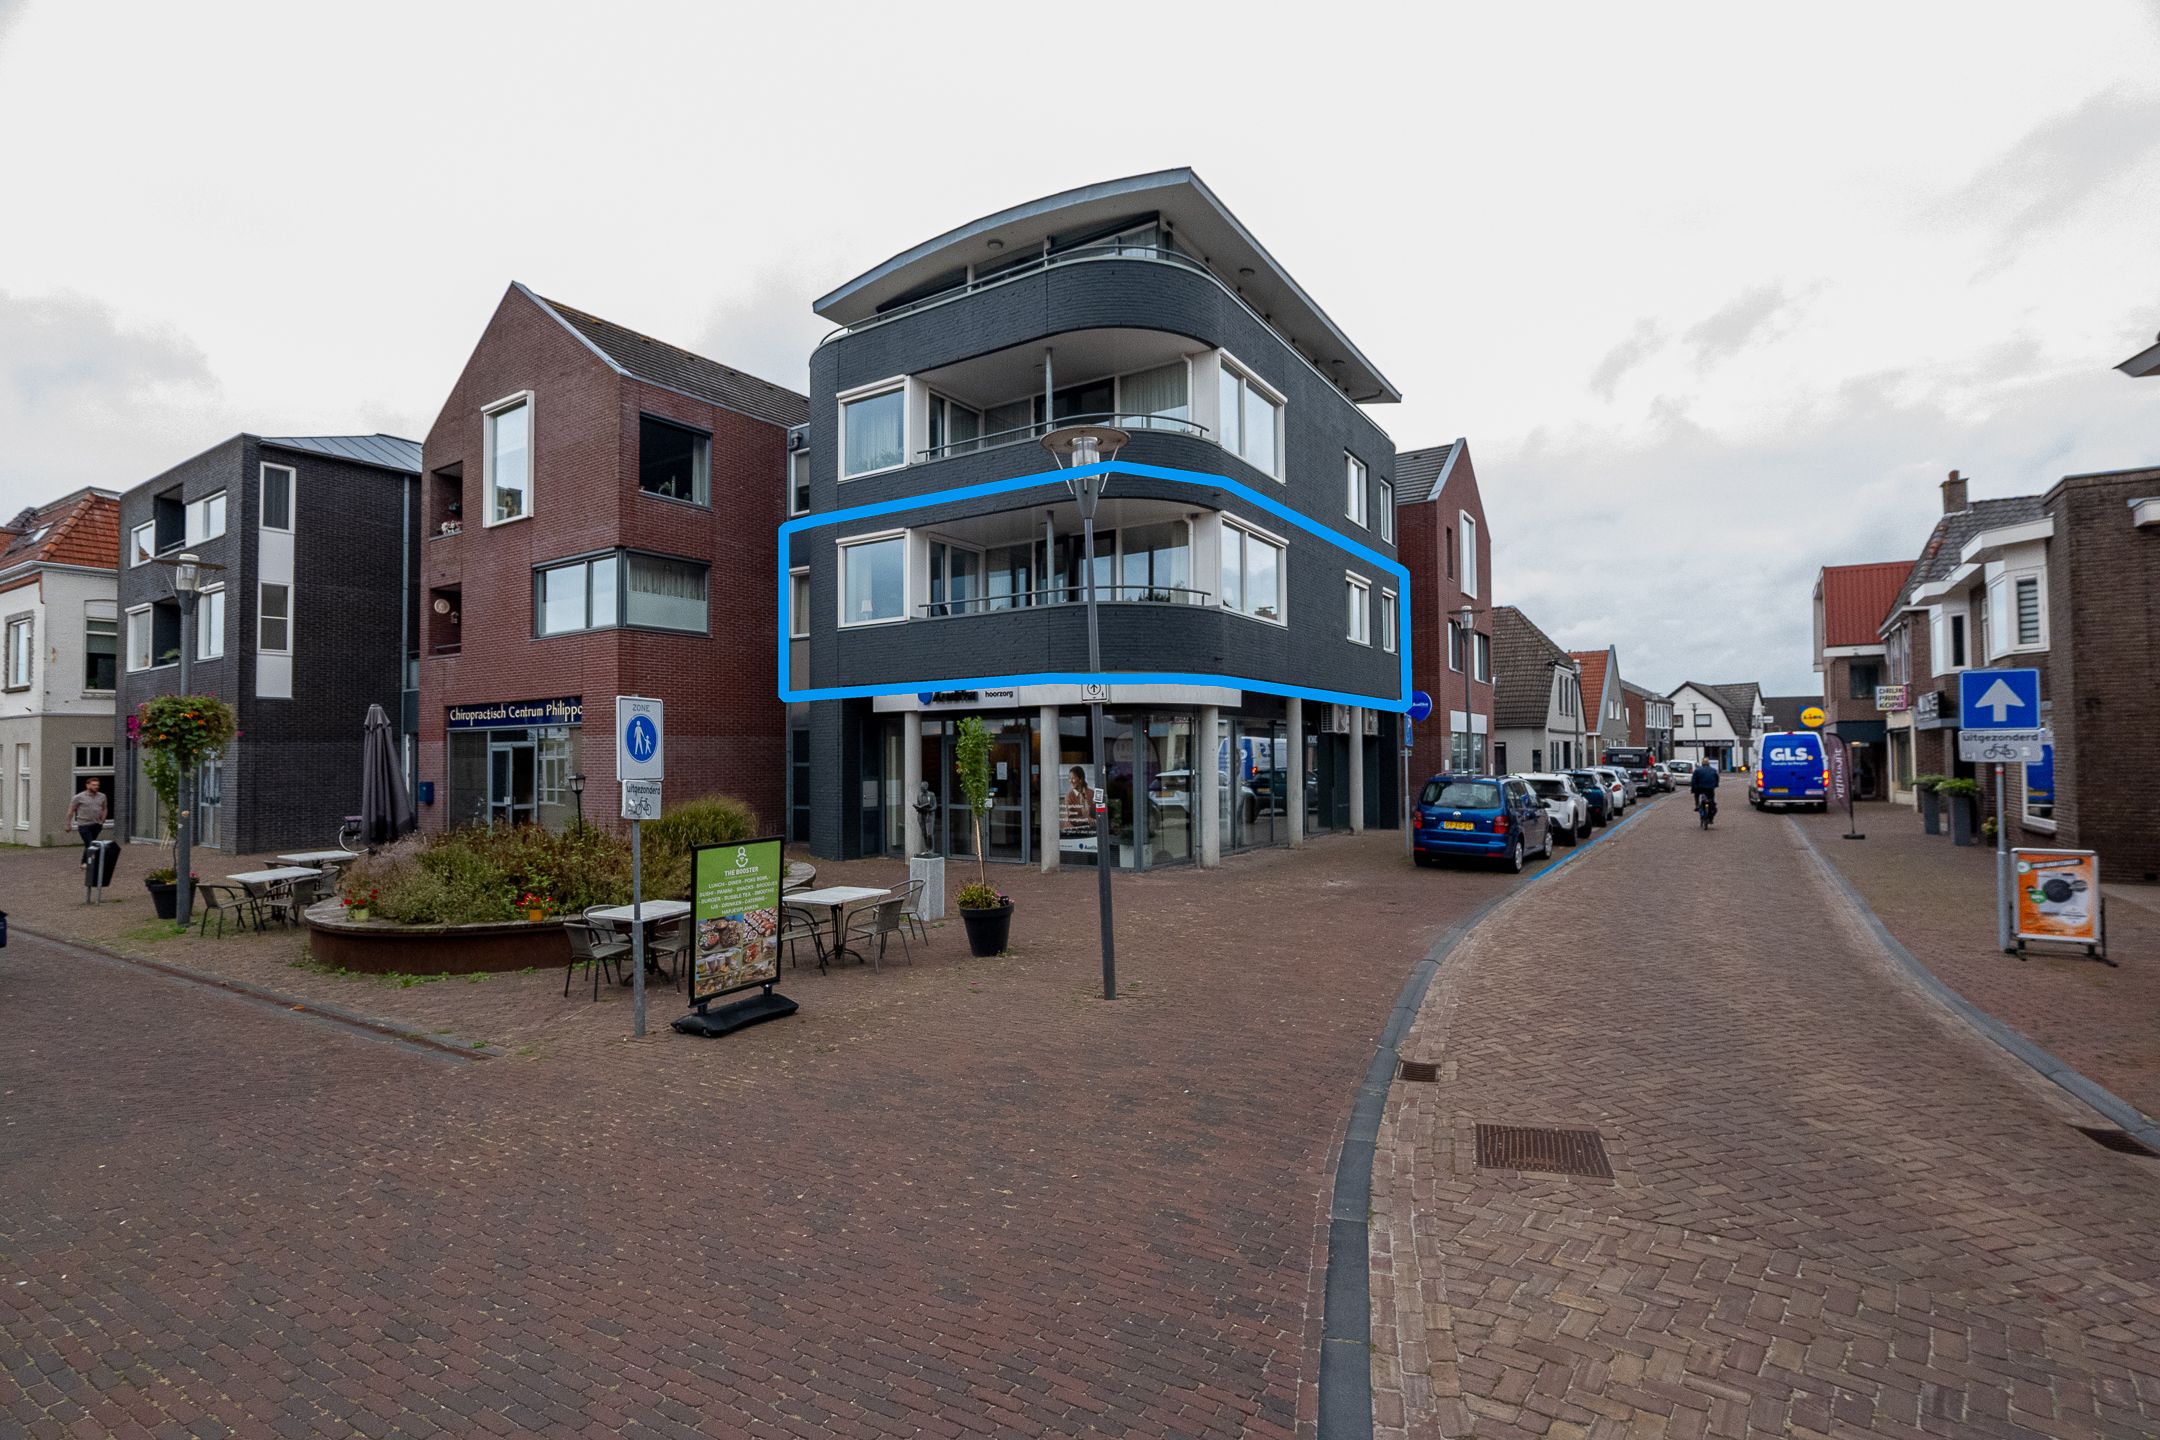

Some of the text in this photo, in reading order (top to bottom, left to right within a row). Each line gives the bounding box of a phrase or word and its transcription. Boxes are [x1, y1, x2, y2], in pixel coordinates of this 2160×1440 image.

[984, 690, 1014, 699] hoorzorg
[632, 703, 651, 712] ZONE
[450, 703, 507, 727] Chiropractisch
[508, 705, 544, 718] Centrum
[1962, 733, 2039, 744] uitgezonderd
[626, 783, 661, 796] uitgezonderd
[736, 867, 759, 876] BOOSTER
